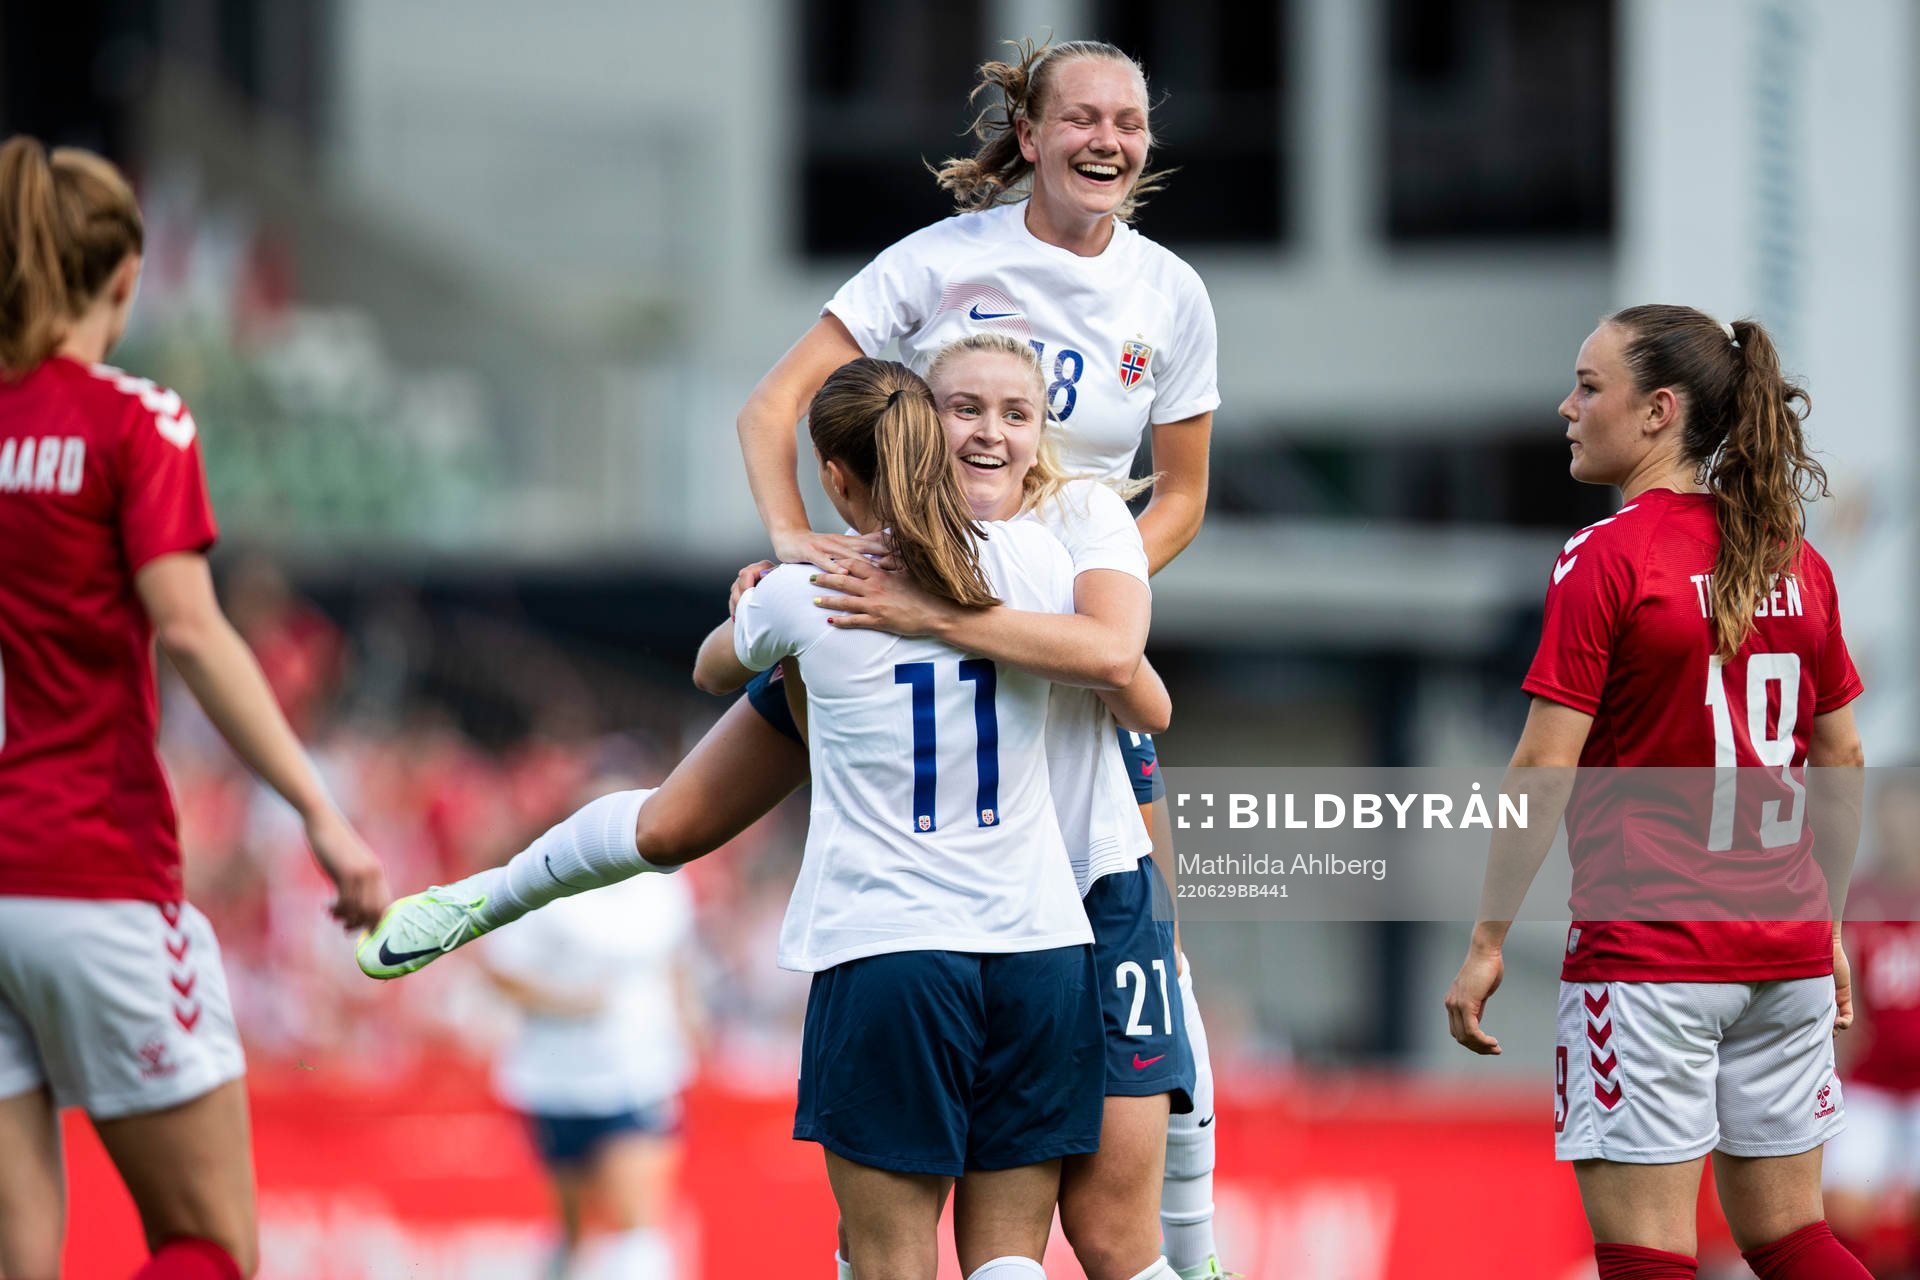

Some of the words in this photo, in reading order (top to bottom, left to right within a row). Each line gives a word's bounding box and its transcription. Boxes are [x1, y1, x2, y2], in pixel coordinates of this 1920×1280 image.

[1690, 574, 1803, 618] TSEN
[895, 658, 1000, 833] 11
[1704, 652, 1807, 852] 19
[1116, 960, 1172, 1036] 21
